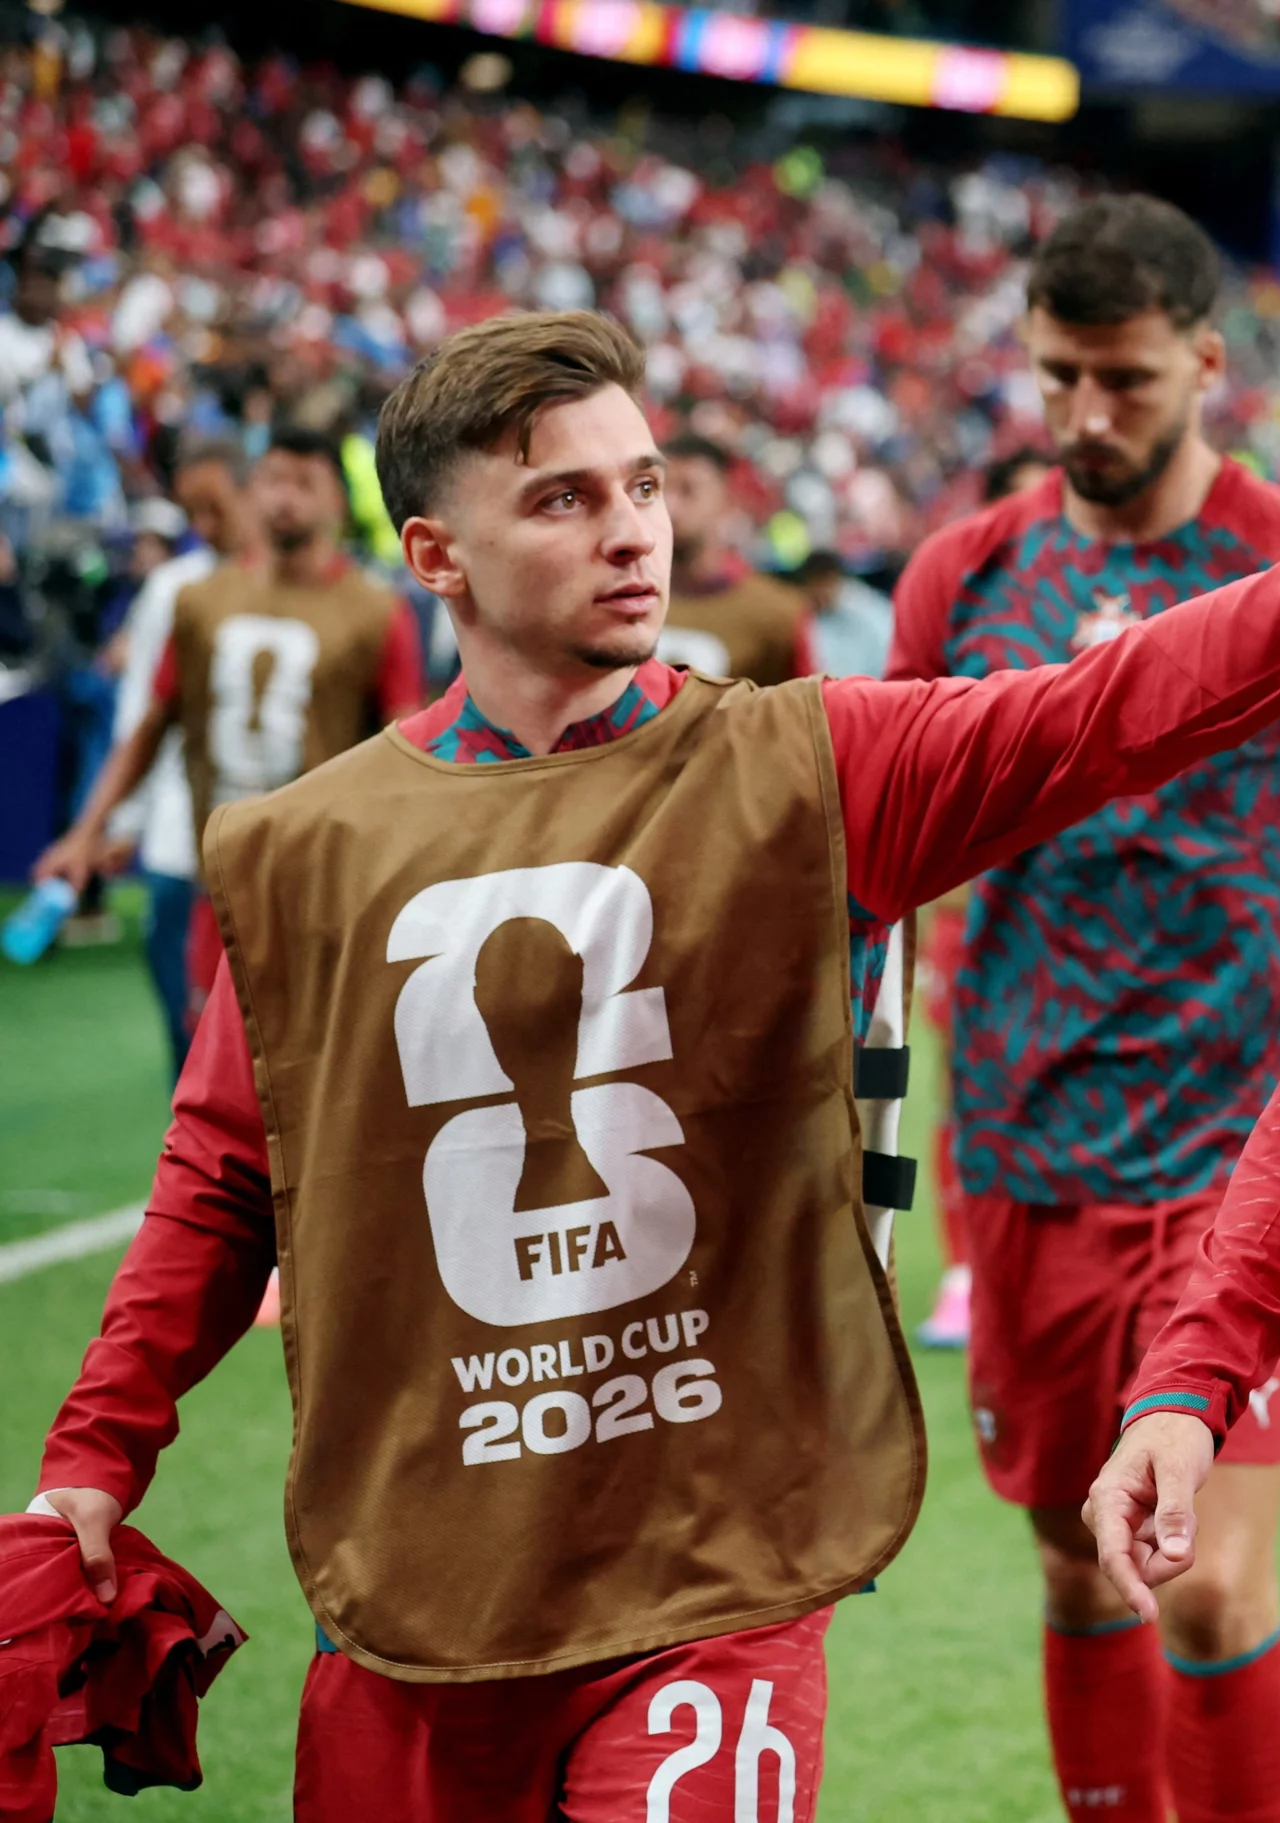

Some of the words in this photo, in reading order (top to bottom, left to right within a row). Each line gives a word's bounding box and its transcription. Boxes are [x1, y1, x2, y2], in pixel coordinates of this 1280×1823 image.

[513, 1220, 628, 1281] FIFA
[450, 1334, 615, 1393] WORLD
[621, 1309, 710, 1359] CUP
[459, 1358, 723, 1466] 2026
[646, 1678, 796, 1823] 26
